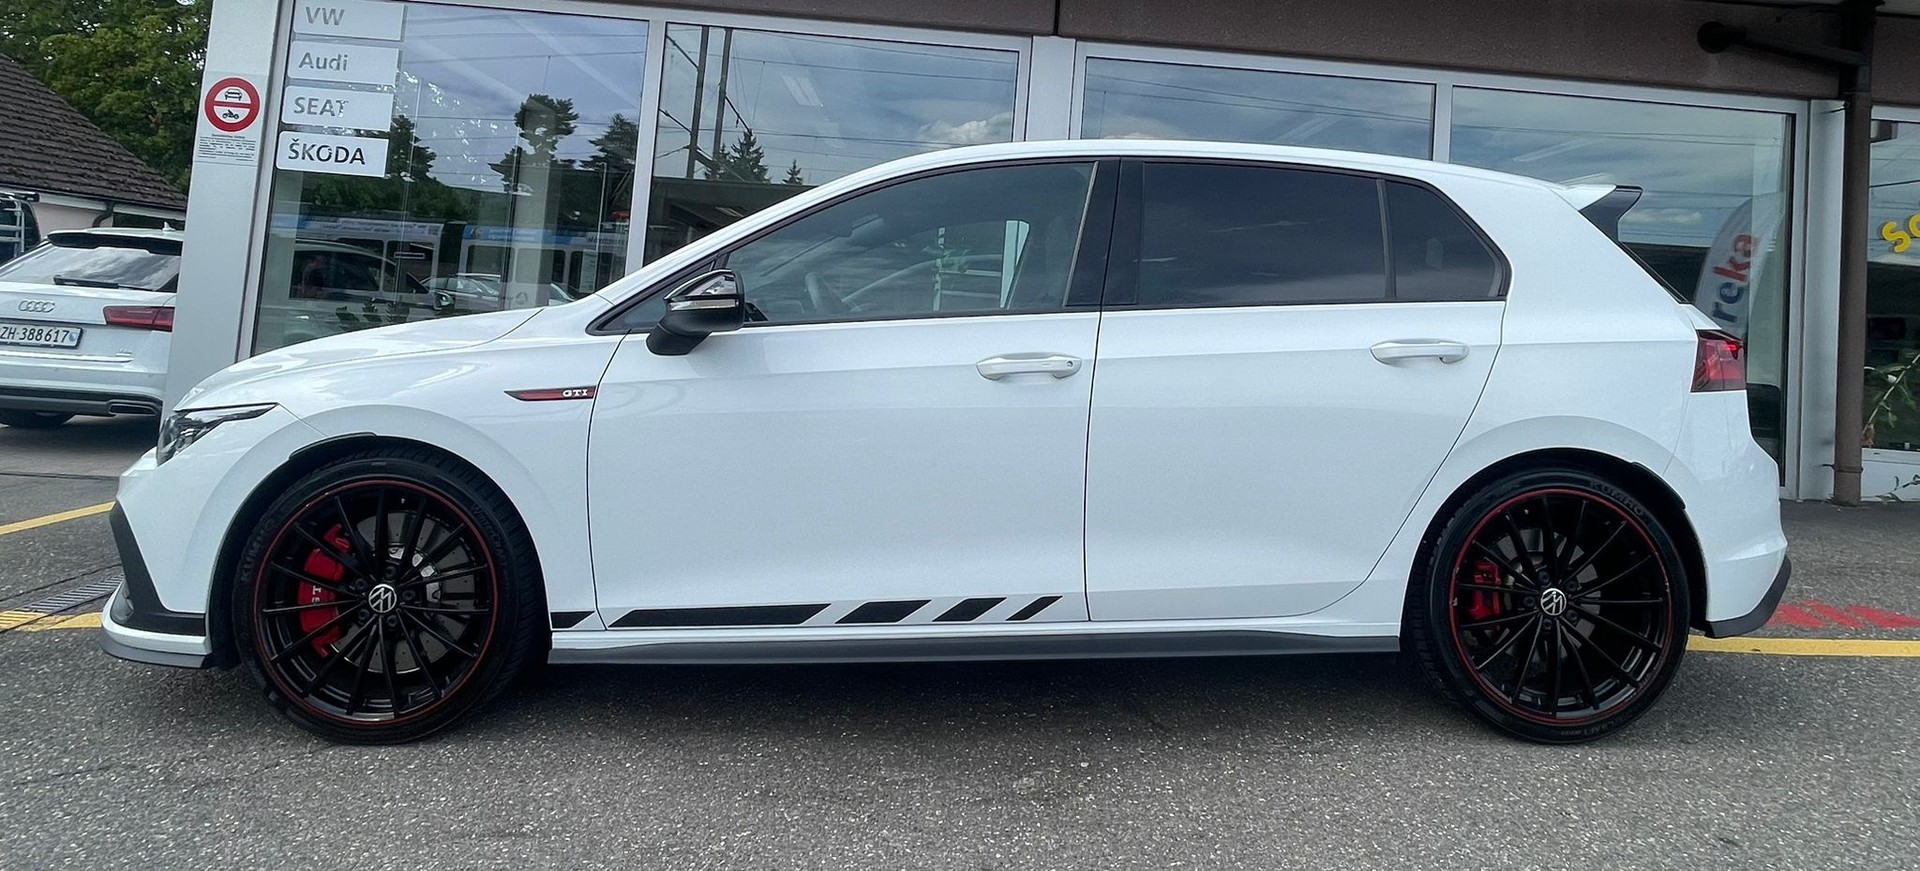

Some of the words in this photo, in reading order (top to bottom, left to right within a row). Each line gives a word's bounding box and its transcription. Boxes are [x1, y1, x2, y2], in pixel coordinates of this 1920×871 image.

[306, 6, 345, 26] VW
[298, 52, 348, 72] Audi
[293, 97, 349, 118] SEAT
[288, 138, 366, 165] ŠKODA
[1713, 234, 1759, 323] reka
[562, 389, 588, 397] GTI
[1590, 480, 1645, 517] KUMHO
